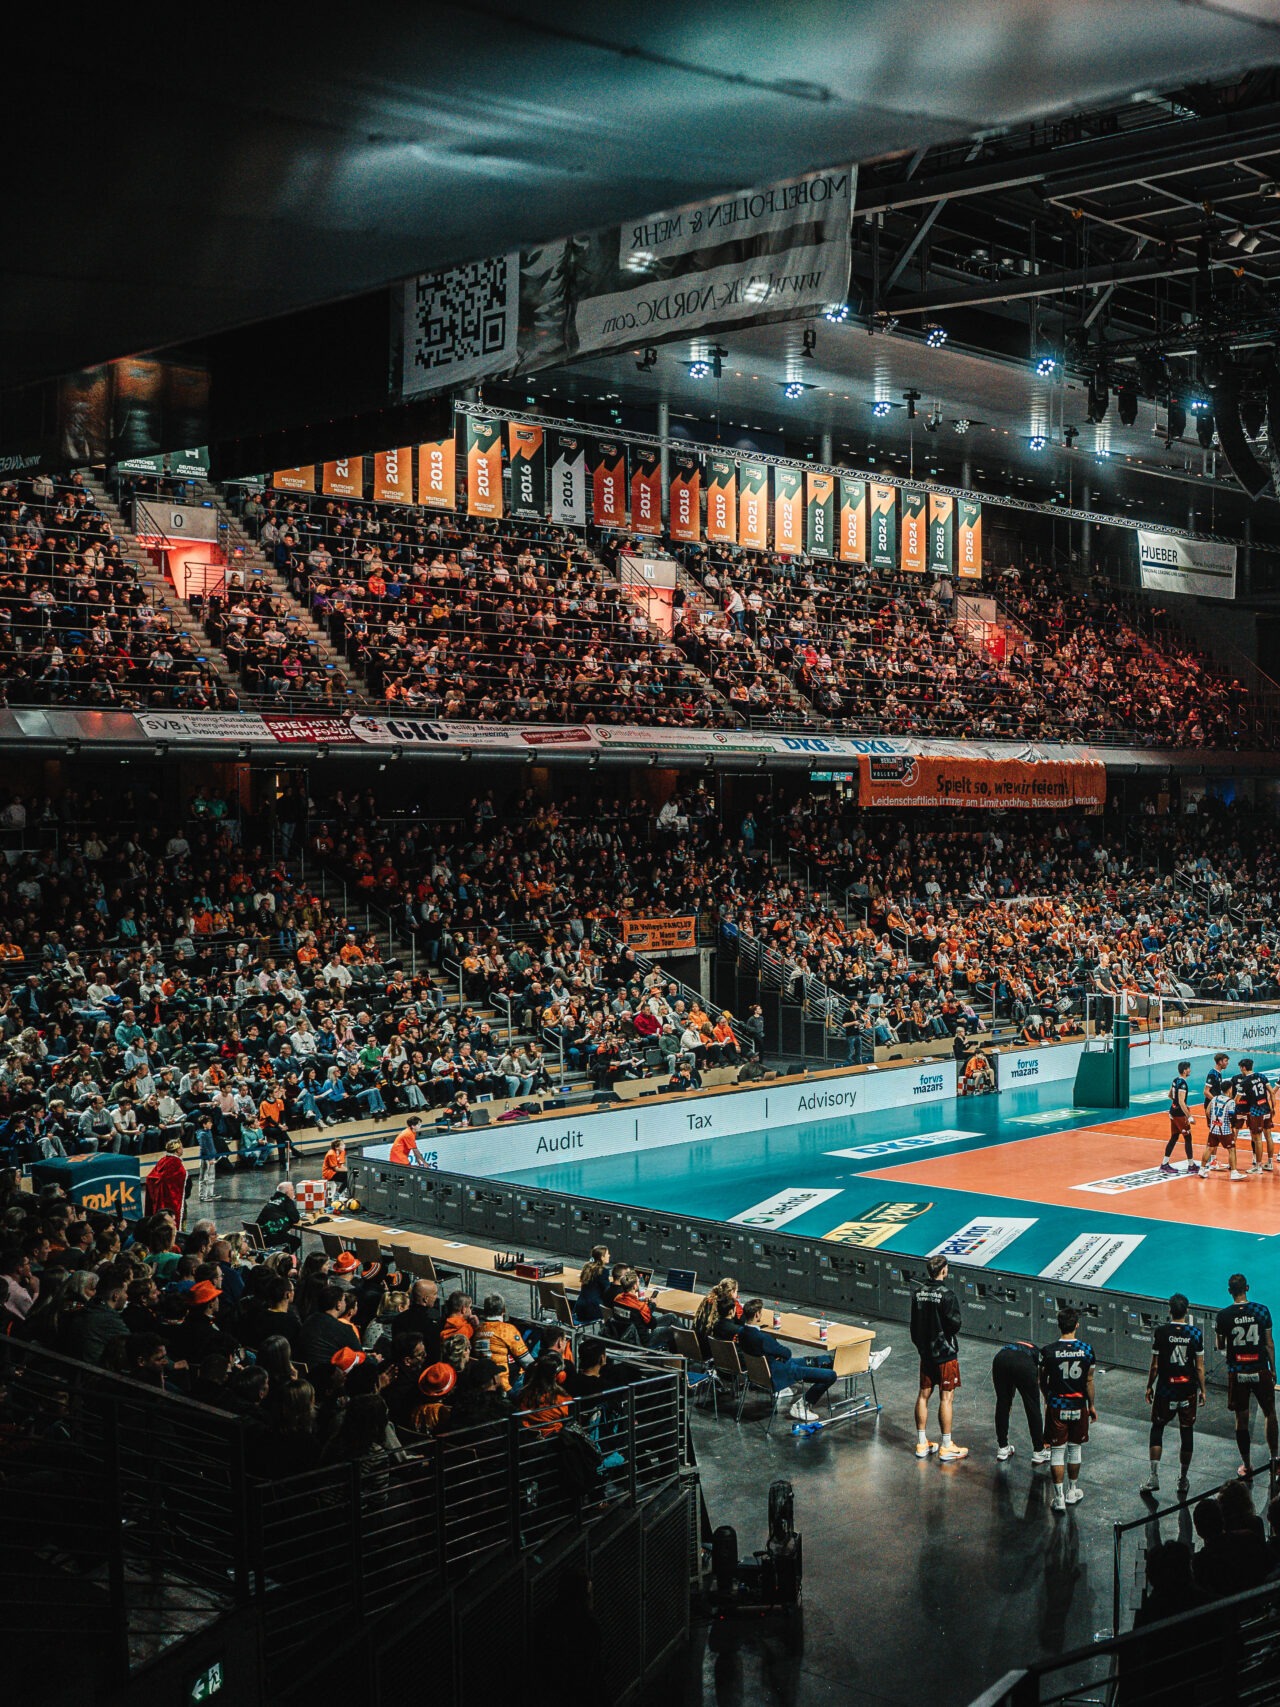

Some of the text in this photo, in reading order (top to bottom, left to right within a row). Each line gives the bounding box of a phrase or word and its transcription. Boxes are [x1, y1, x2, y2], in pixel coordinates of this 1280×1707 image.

[430, 451, 443, 491] 2013
[478, 457, 490, 497] 2014
[521, 464, 533, 503] 2016
[562, 471, 574, 508] 2016
[603, 477, 615, 514] 2016
[640, 483, 651, 519] 2017
[680, 489, 690, 525] 2018
[716, 494, 726, 529] 2019
[748, 499, 757, 533] 2021
[783, 503, 793, 538] 2022
[815, 508, 825, 543] 2023
[847, 514, 857, 547] 2023
[878, 518, 887, 551] 2024
[909, 522, 918, 555] 2024
[935, 527, 944, 559] 2025
[966, 531, 975, 563] 2025
[1141, 545, 1178, 563] HUEBER
[646, 566, 653, 577] N
[146, 720, 182, 731] SVB
[268, 719, 346, 730] SPIEL MIT IM
[275, 729, 313, 738] TEAM
[445, 723, 475, 732] Facility
[781, 737, 830, 752] DKB
[851, 739, 896, 754] DKB
[937, 774, 971, 795] Spielt
[974, 780, 991, 797] so,
[966, 798, 977, 807] am
[980, 797, 999, 807] Limit
[1242, 1024, 1278, 1041] Advisory
[1010, 1067, 1039, 1078] mazars
[1017, 1058, 1039, 1070] forvis
[912, 1082, 944, 1096] mazars
[921, 1073, 944, 1085] forvis
[1252, 1082, 1265, 1097] 13
[797, 1089, 857, 1113] Advisory
[686, 1112, 713, 1131] Tax
[535, 1129, 584, 1155] Audit
[852, 1139, 929, 1155] DKB
[82, 1180, 136, 1210] mkk
[760, 1192, 818, 1216] bechtle
[938, 1238, 978, 1256] park
[1231, 1324, 1260, 1346] 24
[1055, 1350, 1086, 1358] Eckardt
[1169, 1345, 1187, 1366] 4
[1058, 1361, 1083, 1380] 16
